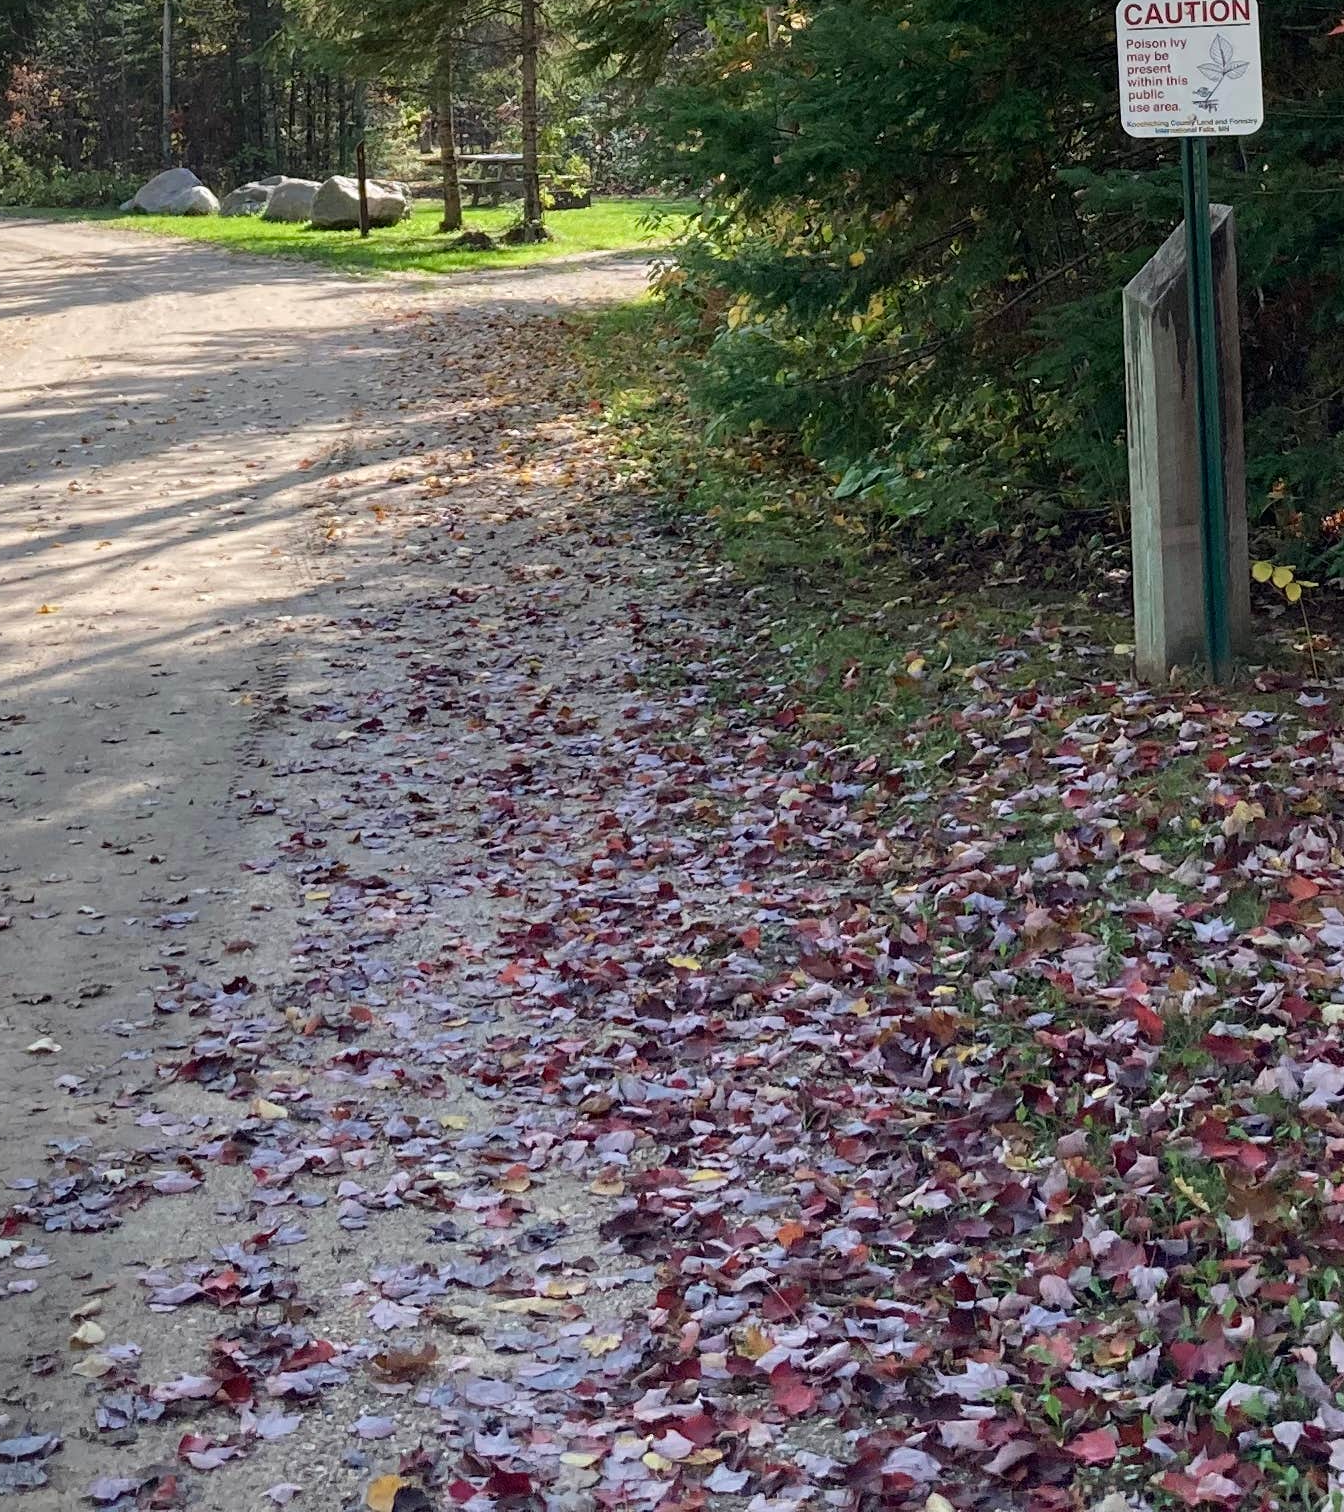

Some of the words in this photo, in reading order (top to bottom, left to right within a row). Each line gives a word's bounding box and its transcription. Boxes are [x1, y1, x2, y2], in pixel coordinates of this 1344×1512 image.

[1124, 0, 1250, 25] CAUTION
[1127, 39, 1166, 49] Poison
[1170, 38, 1187, 49] Ivy
[1127, 53, 1151, 63] may
[1154, 52, 1168, 61] be
[1128, 64, 1171, 76] present
[1128, 76, 1163, 87] within
[1167, 75, 1188, 85] this
[1128, 89, 1165, 101] public
[1129, 103, 1150, 112] use
[1153, 102, 1181, 112] area.
